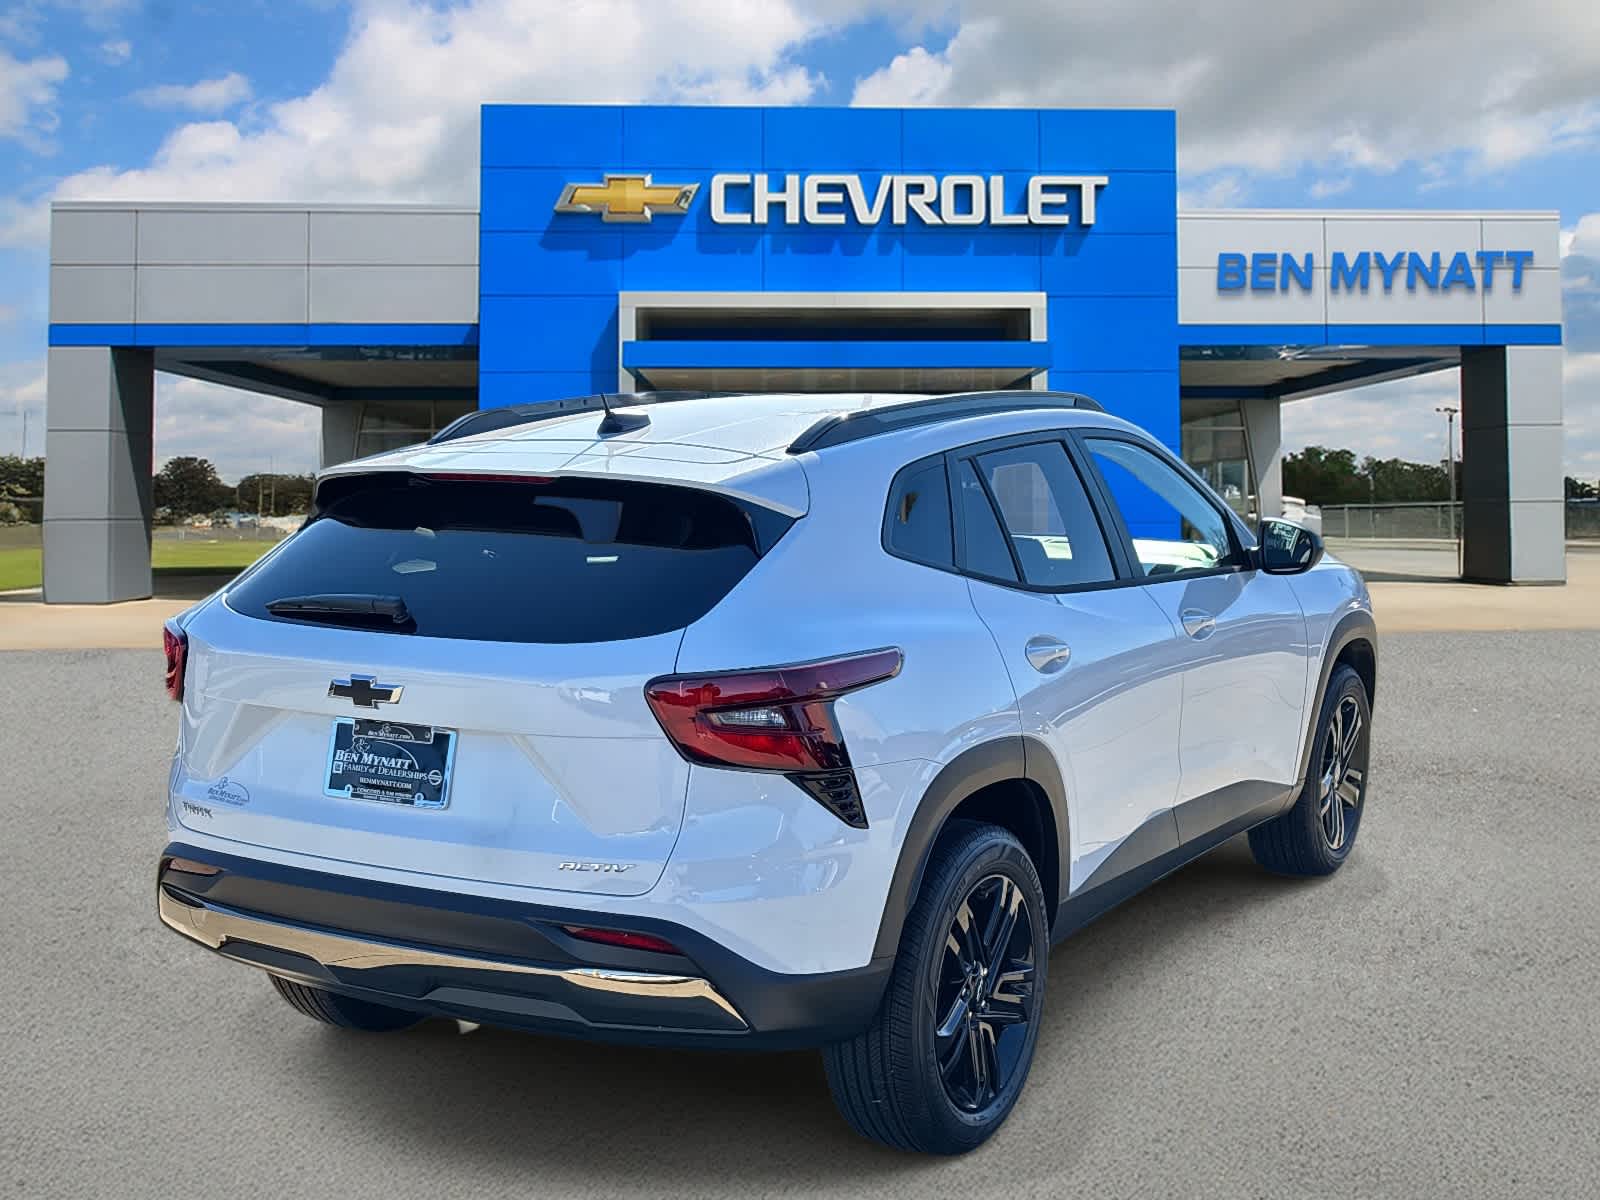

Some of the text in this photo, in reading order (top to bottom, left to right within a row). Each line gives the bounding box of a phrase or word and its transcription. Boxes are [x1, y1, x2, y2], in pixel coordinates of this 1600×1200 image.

[711, 173, 1109, 225] CHEVROLET
[1217, 251, 1533, 290] BEN MYNATT
[335, 750, 412, 769] BEN MYNATT
[343, 762, 369, 772] FAMILY
[378, 767, 428, 781] DEALERSHIPS
[359, 776, 412, 789] BENMYNATT.COM
[559, 862, 636, 872] ACTIV
